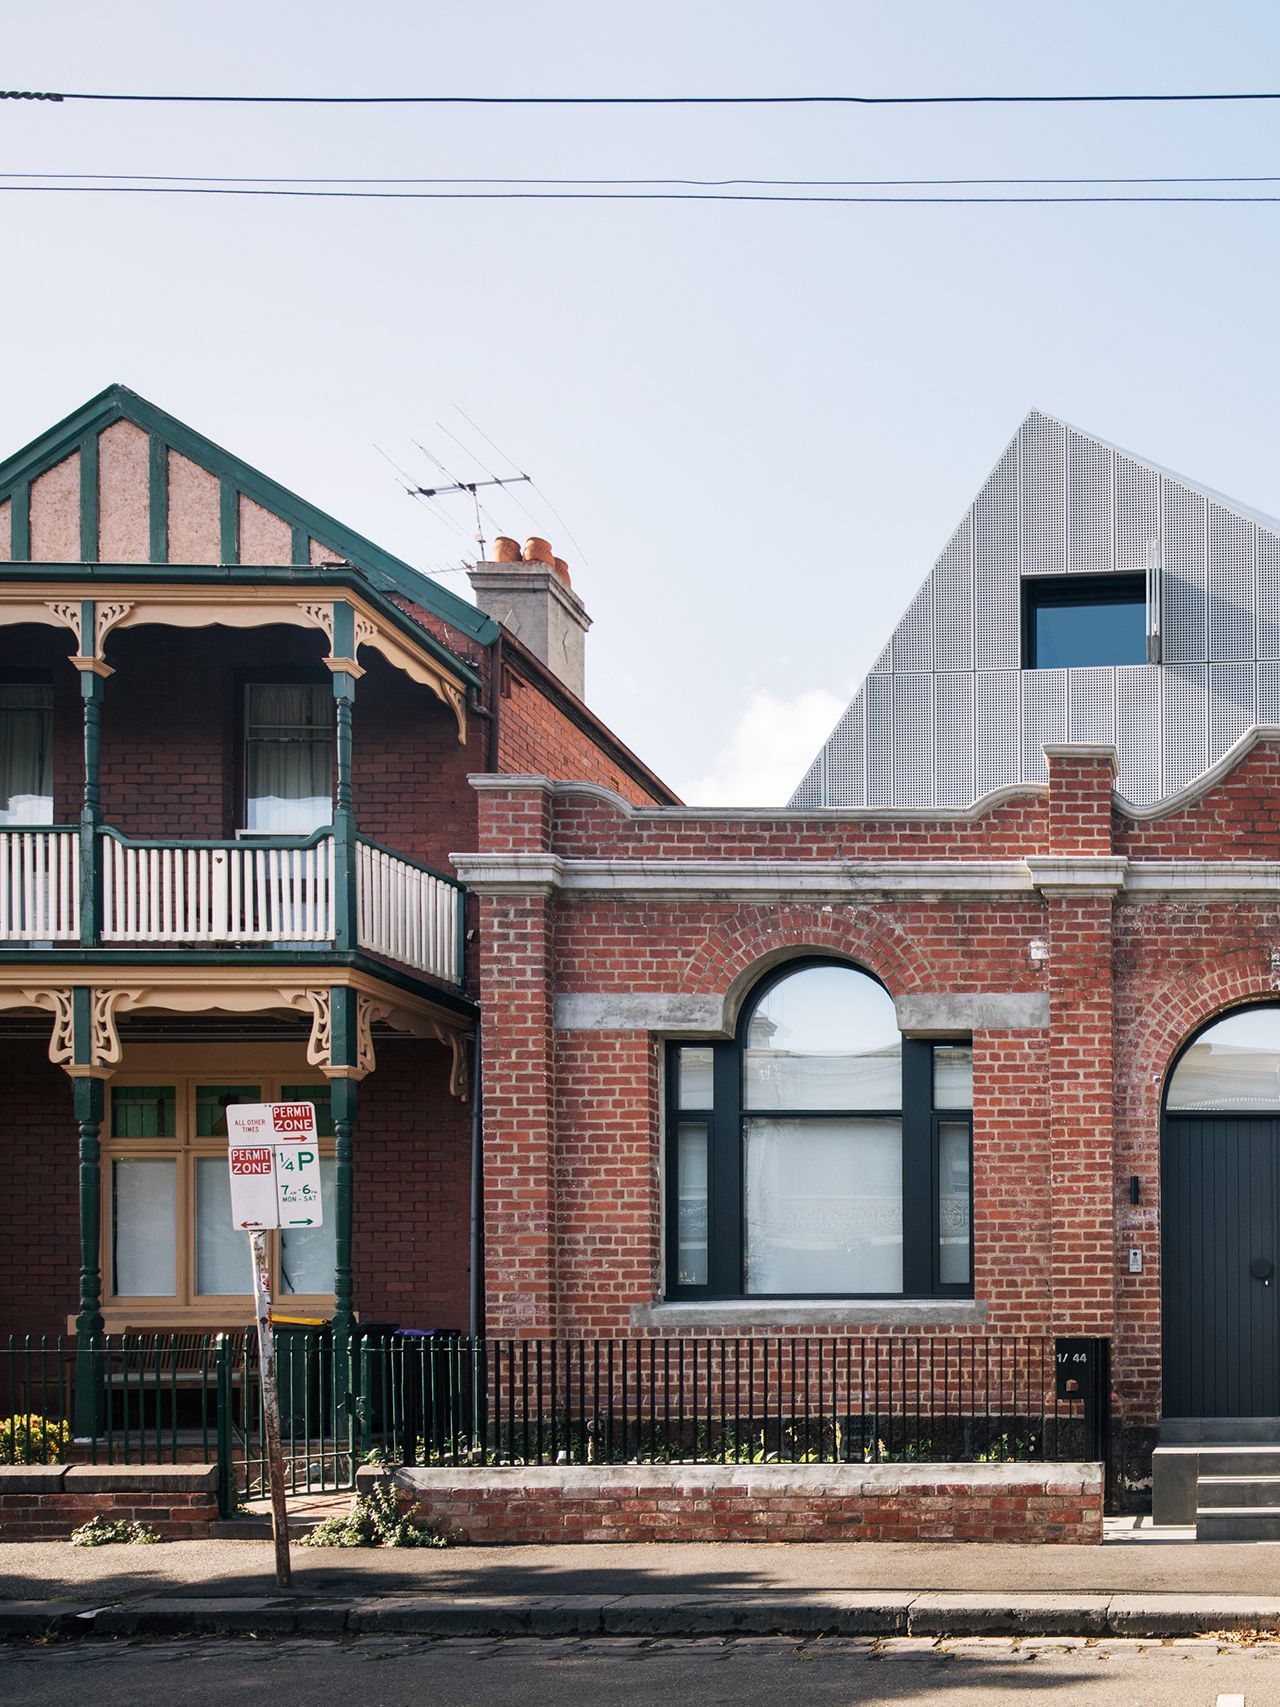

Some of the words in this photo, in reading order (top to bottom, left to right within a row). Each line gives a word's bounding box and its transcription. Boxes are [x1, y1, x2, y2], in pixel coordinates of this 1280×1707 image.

[273, 1106, 311, 1118] PERMIT
[274, 1119, 313, 1131] ZONE
[232, 1149, 269, 1161] PERMIT
[232, 1162, 270, 1174] ZONE
[1072, 1353, 1087, 1363] 44
